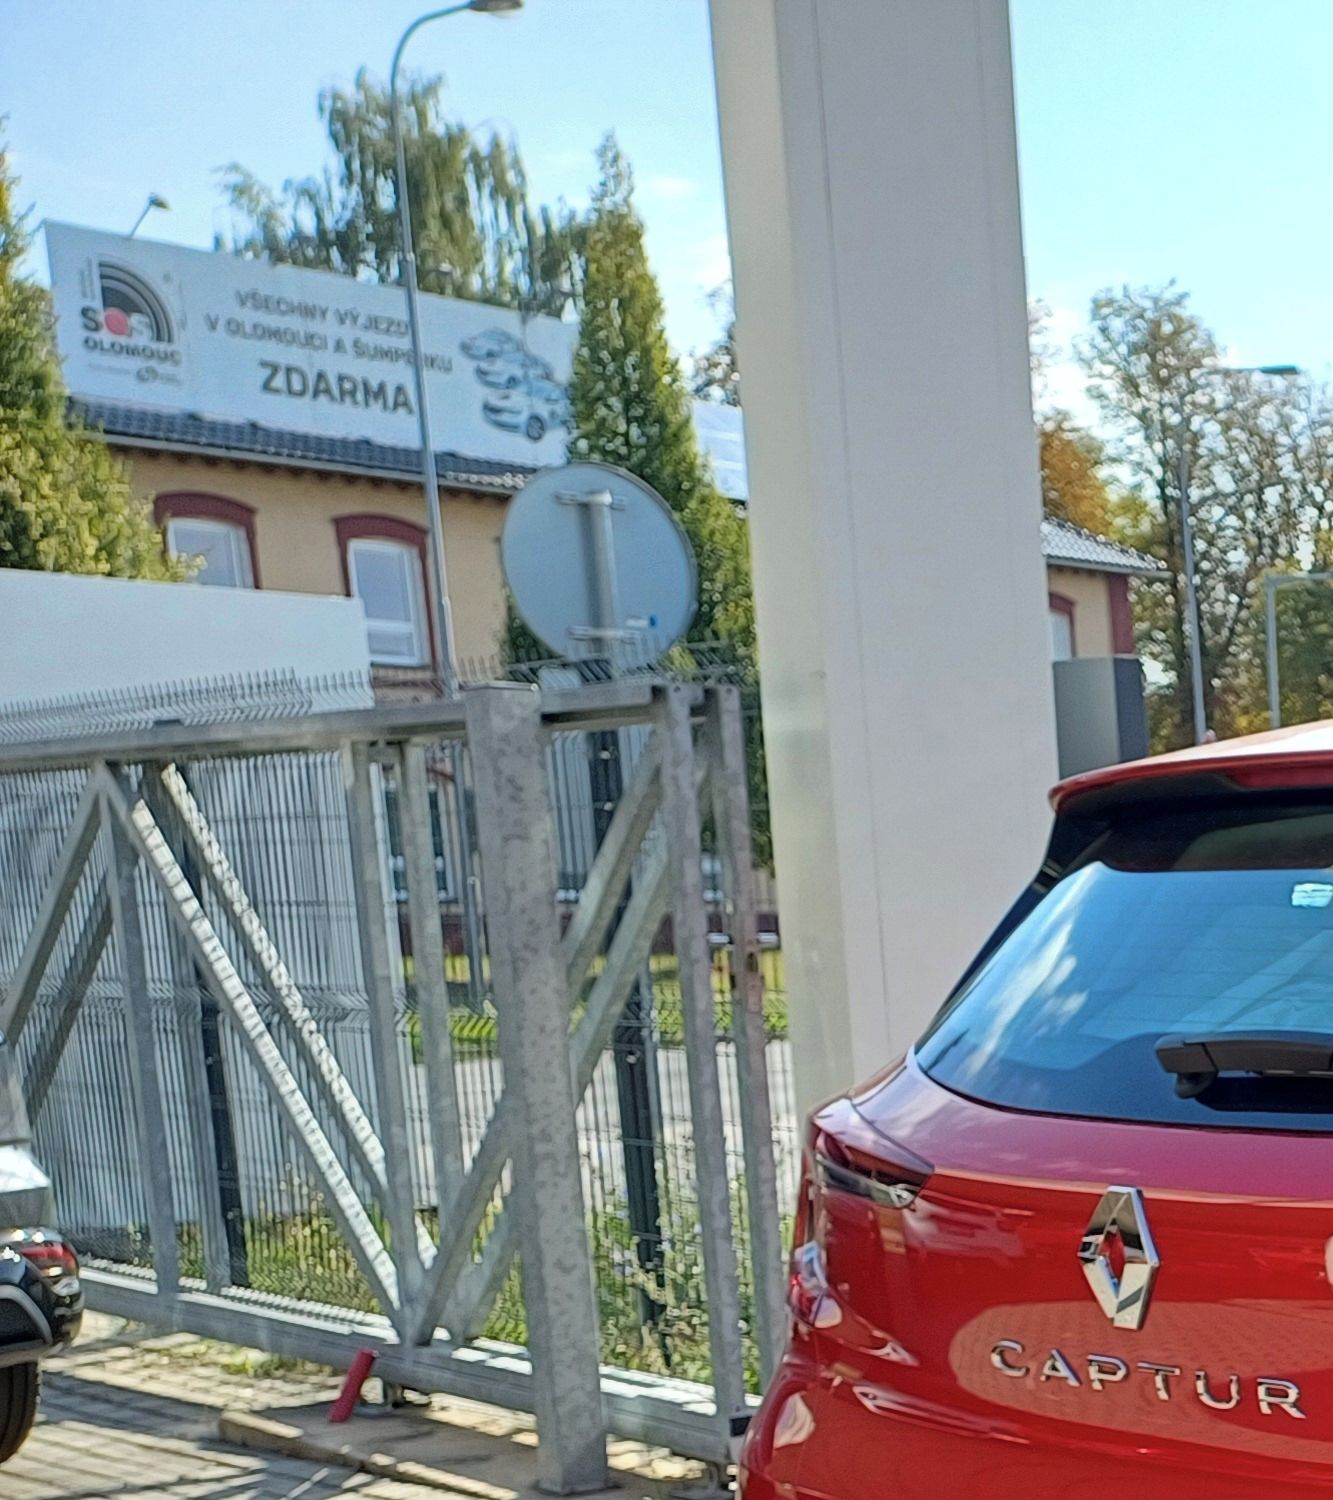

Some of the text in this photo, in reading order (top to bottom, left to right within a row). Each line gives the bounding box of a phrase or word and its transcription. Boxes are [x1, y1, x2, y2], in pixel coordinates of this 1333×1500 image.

[204, 312, 219, 332] V
[225, 317, 329, 351] OLOMOUCI
[334, 337, 348, 354] A
[235, 288, 414, 338] VŠECHNY VÝJEZD
[83, 336, 182, 366] OLOMOUC
[259, 358, 416, 416] ZDARMA
[990, 1339, 1307, 1419] CAPTUR
